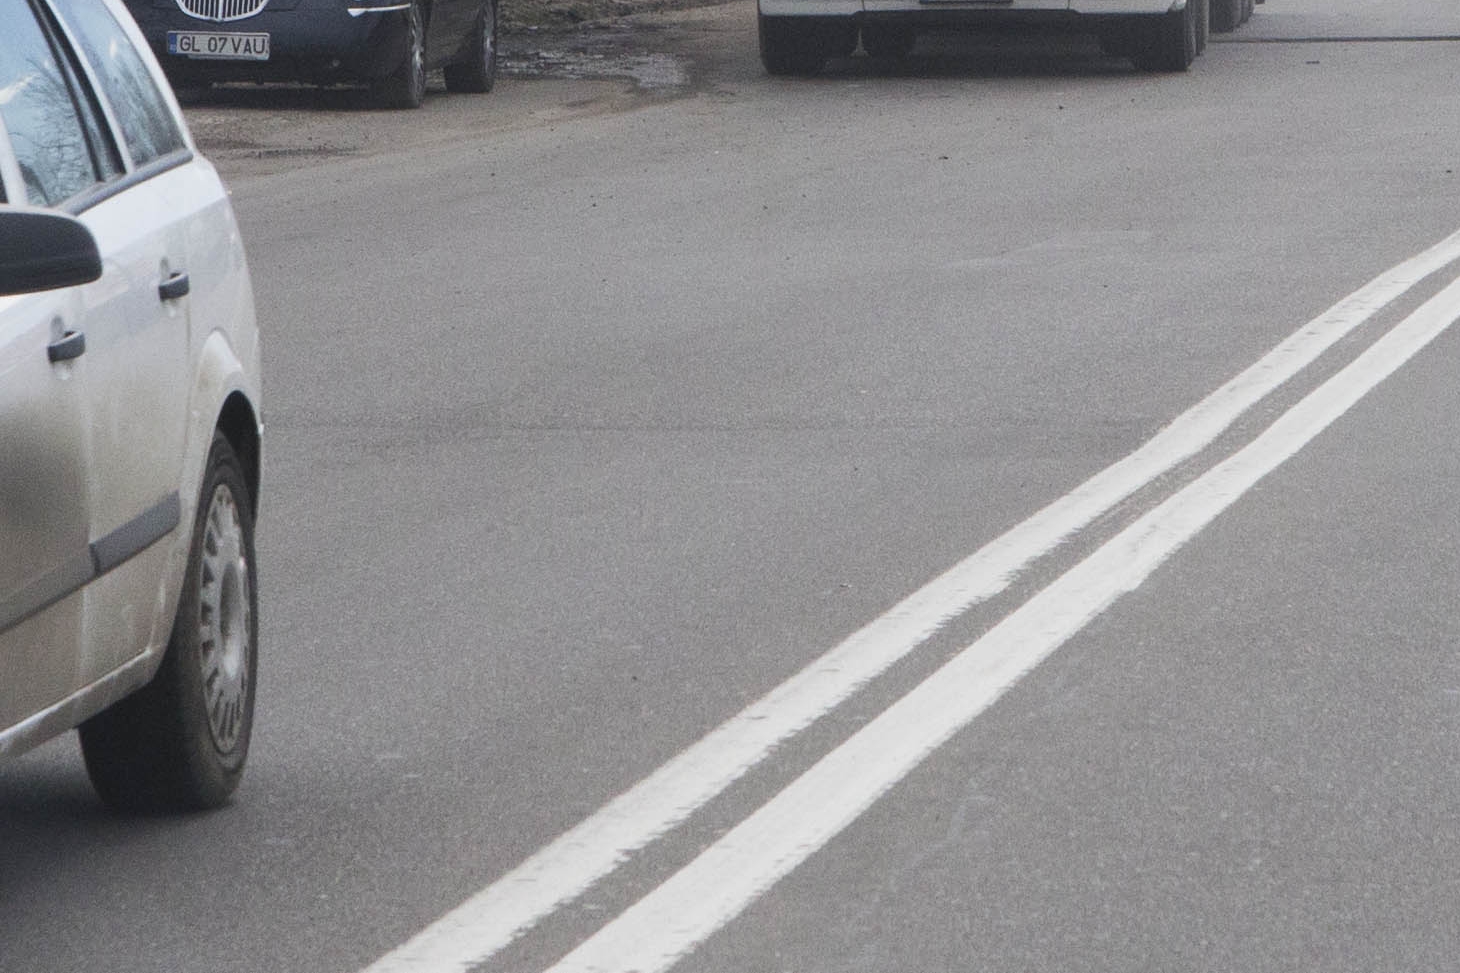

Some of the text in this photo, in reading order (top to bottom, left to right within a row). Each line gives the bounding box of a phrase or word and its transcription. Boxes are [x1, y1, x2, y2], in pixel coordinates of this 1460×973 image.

[180, 36, 265, 54] GL 07 VAU
